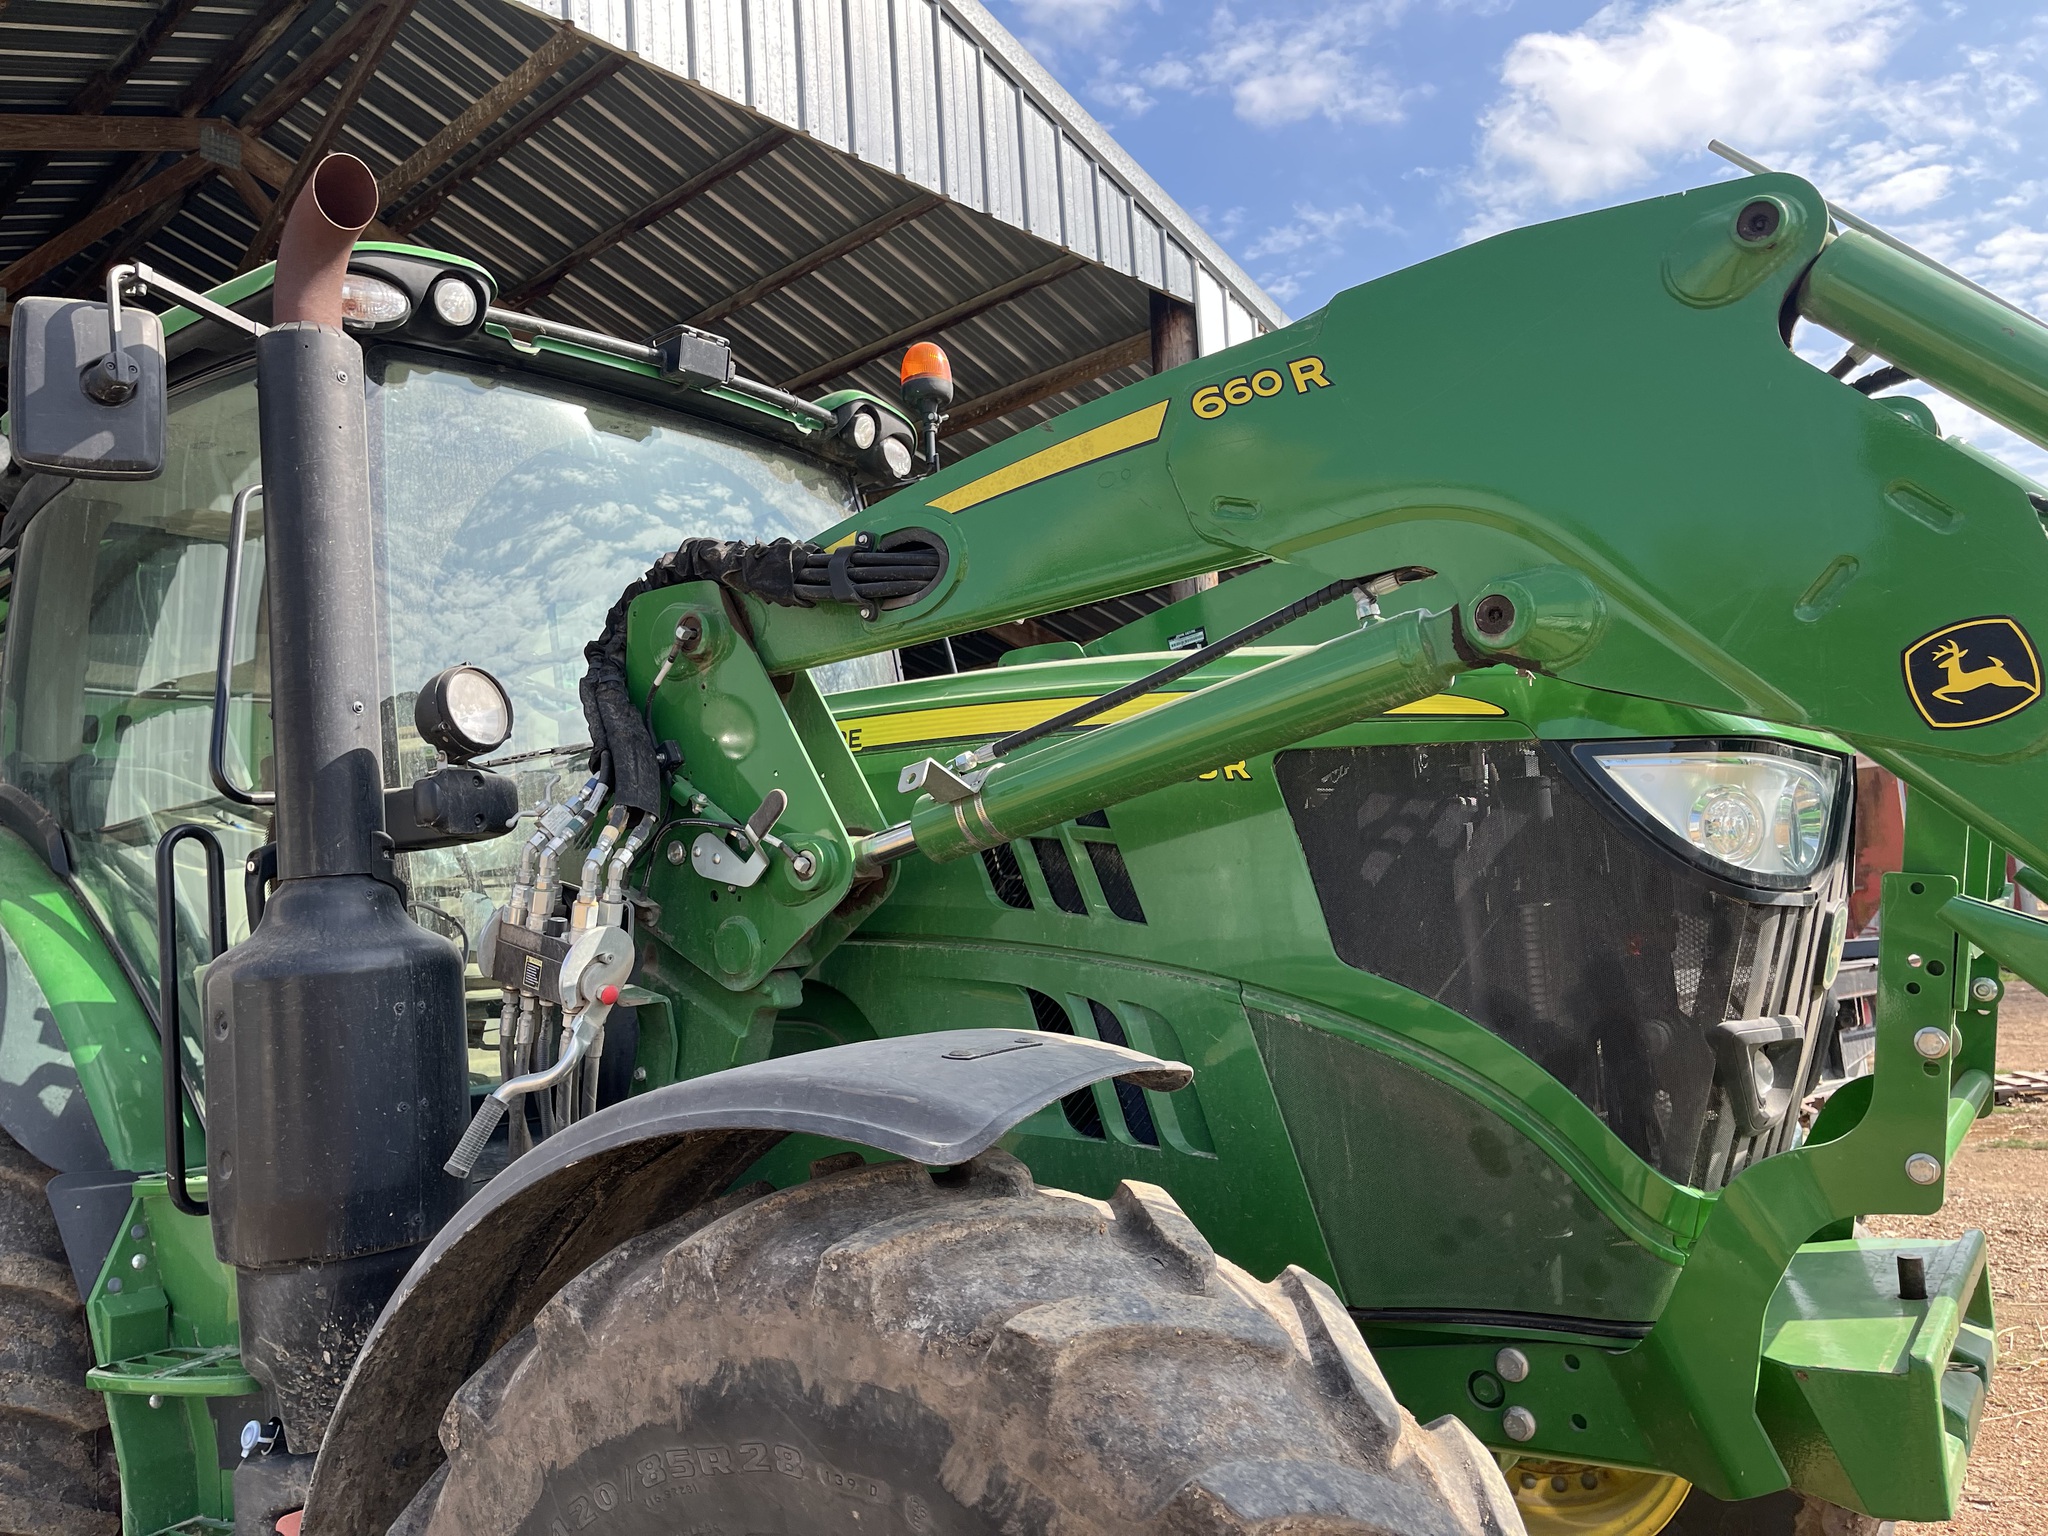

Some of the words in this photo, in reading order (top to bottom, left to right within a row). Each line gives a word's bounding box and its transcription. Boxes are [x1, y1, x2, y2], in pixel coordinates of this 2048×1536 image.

[1191, 368, 1284, 419] 660
[1286, 355, 1335, 395] R
[841, 728, 862, 749] E
